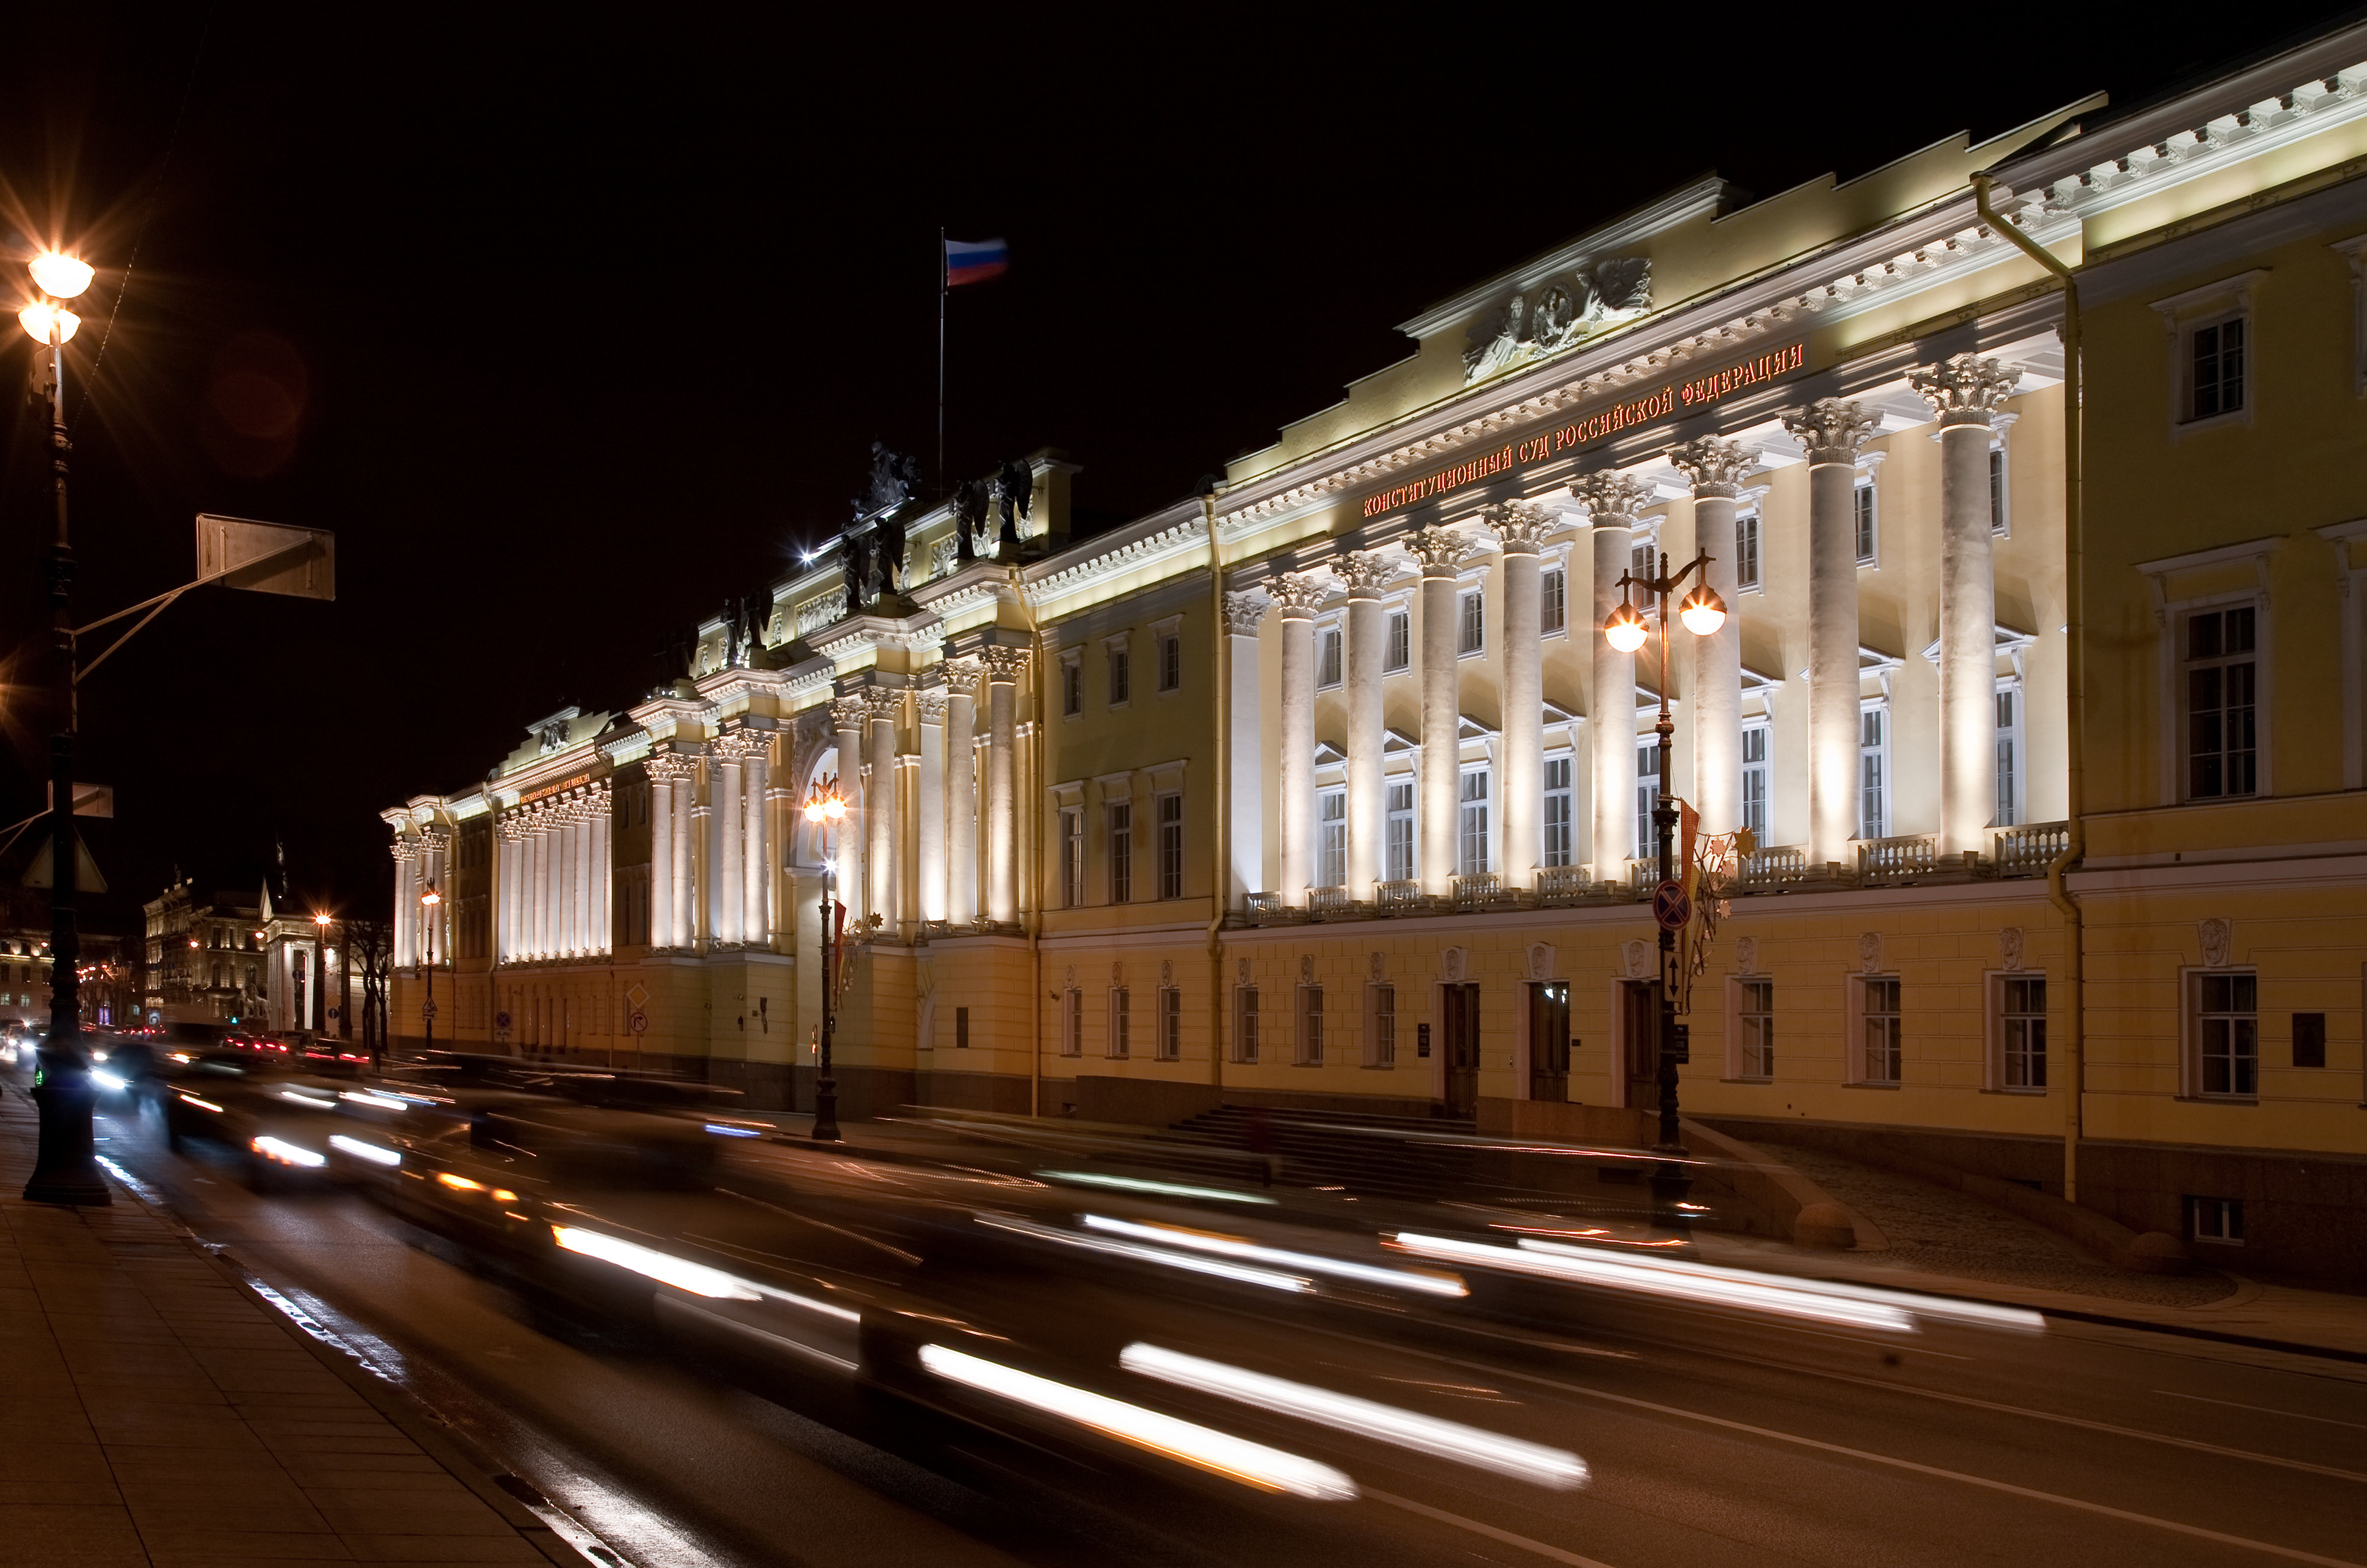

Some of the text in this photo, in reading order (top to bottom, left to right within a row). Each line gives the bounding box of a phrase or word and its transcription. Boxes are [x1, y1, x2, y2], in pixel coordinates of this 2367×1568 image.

[1364, 344, 1803, 517] КОНСТИТУЦИОННЫЙ СУД РОССИЙСКОЙ ФЕДЕРАЦИИ
